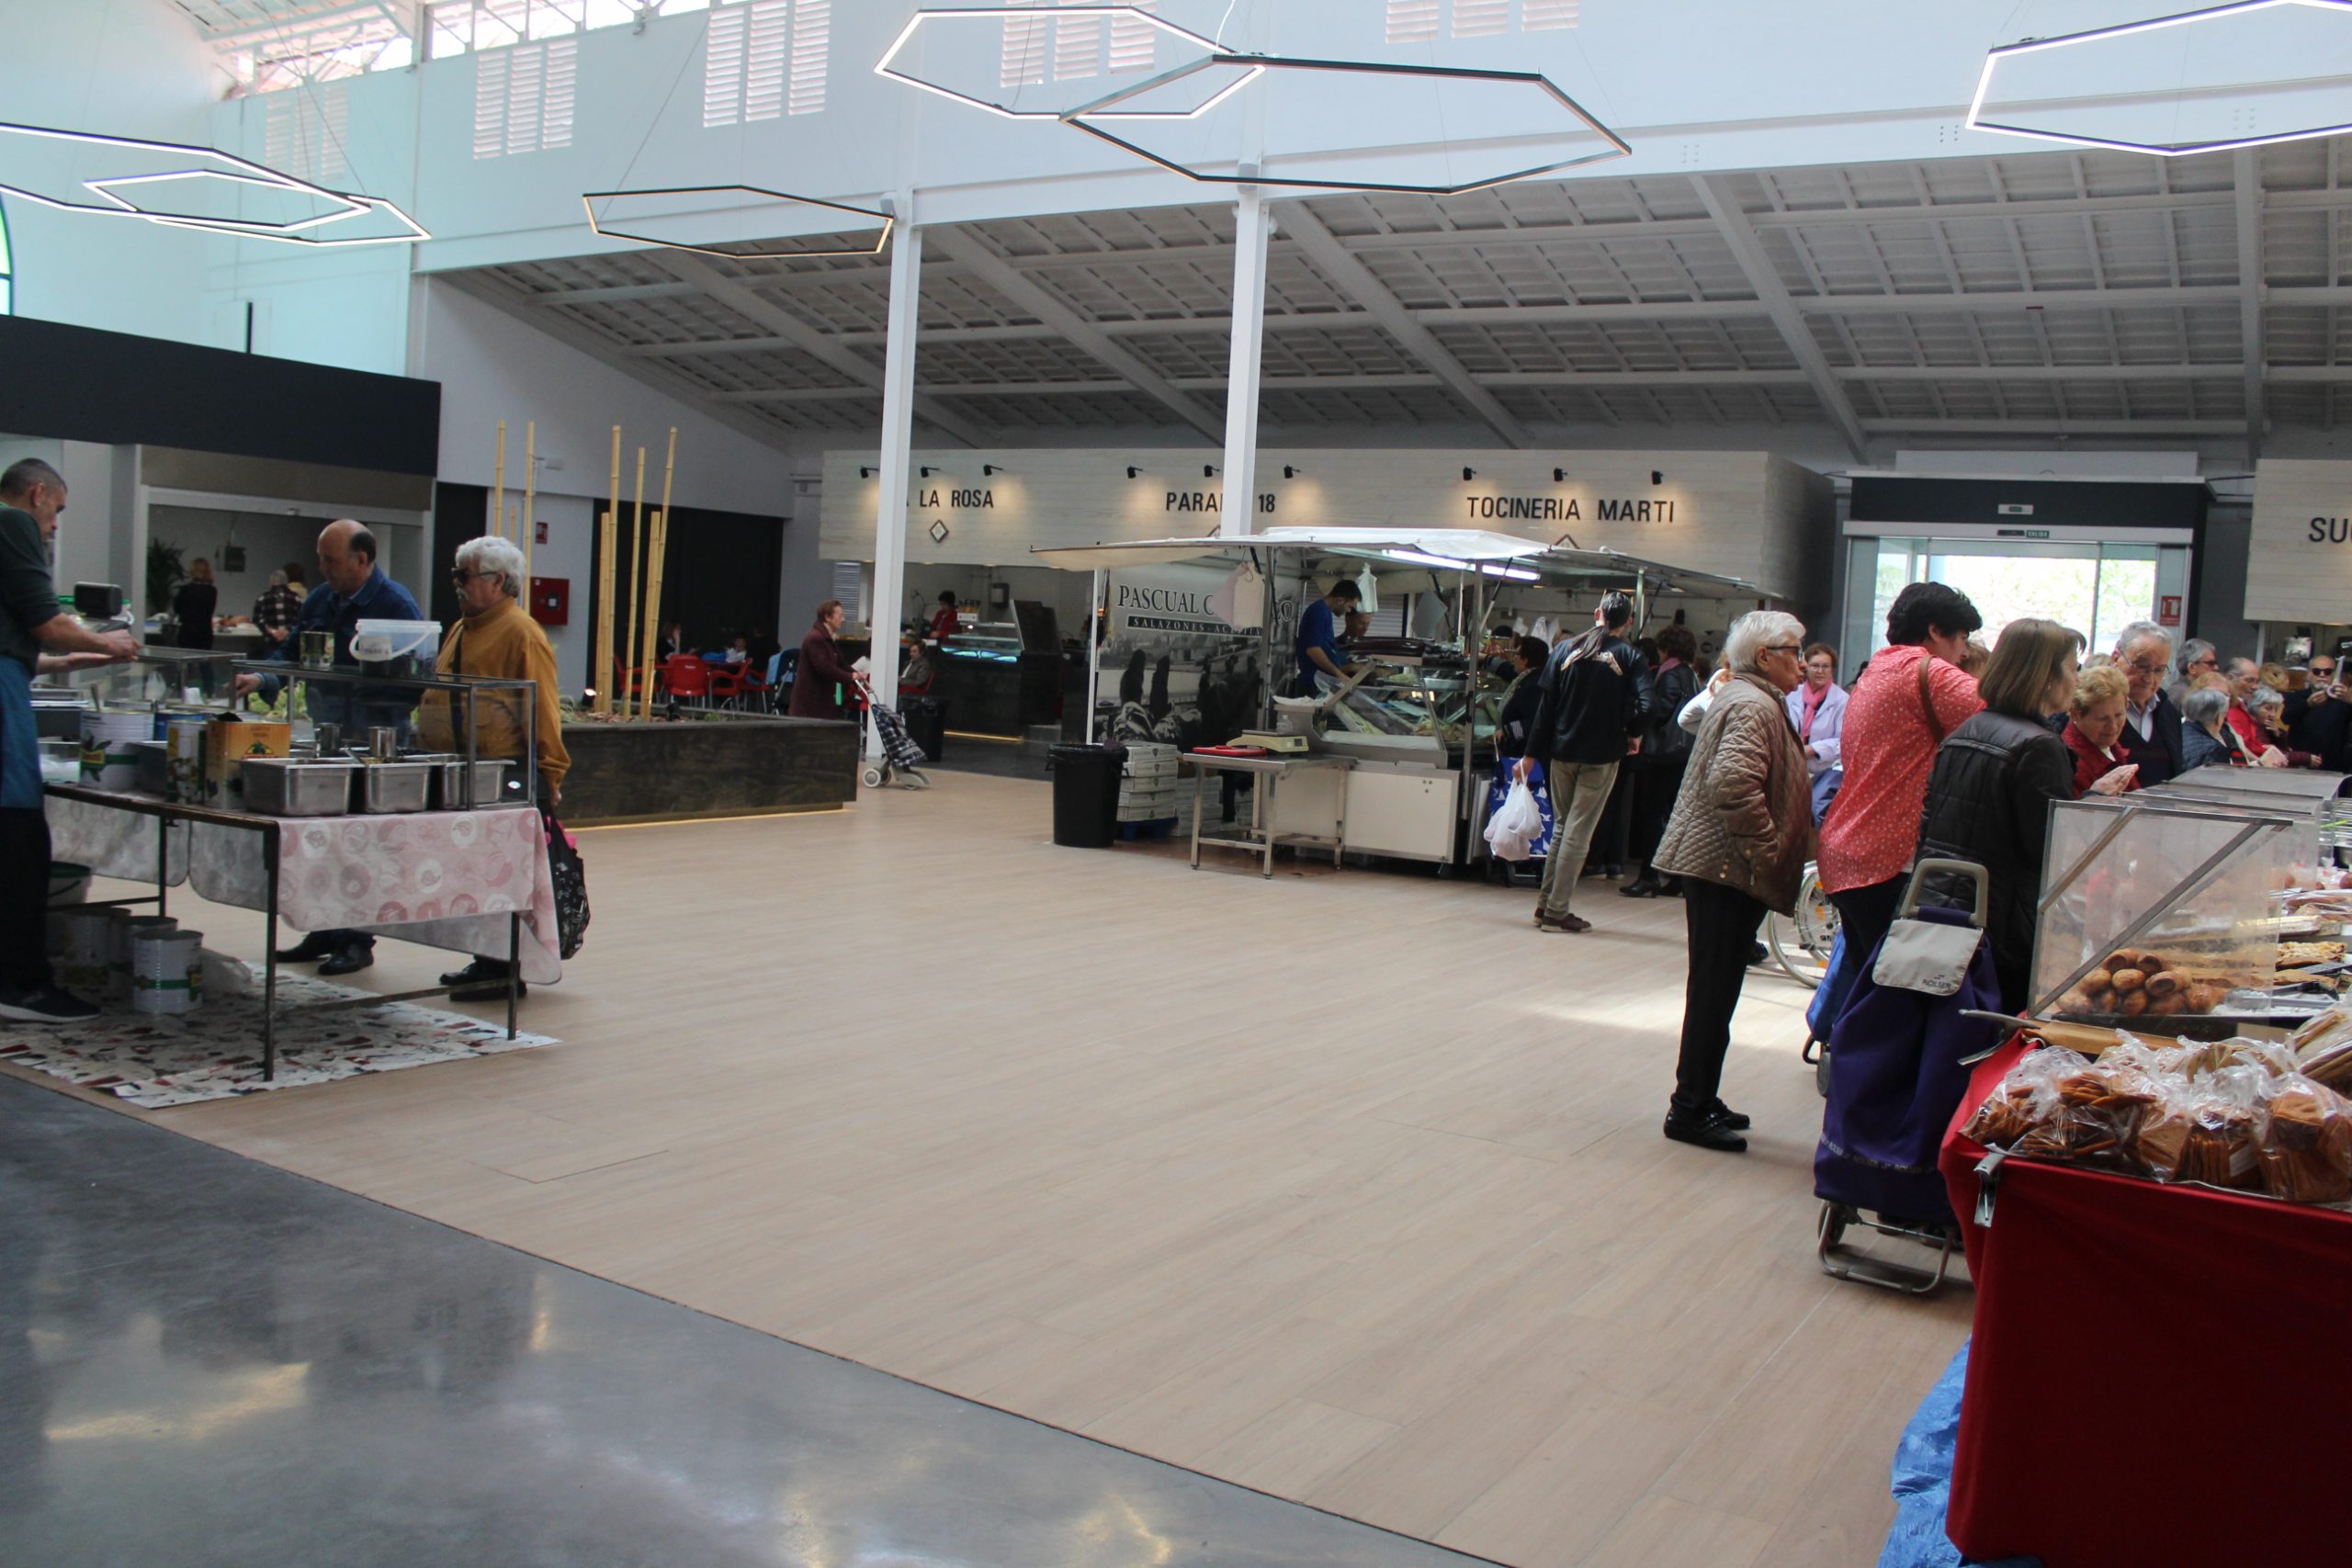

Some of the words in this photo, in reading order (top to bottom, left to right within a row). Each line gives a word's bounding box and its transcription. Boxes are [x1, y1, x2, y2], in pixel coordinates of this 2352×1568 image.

[920, 489, 940, 508] LA
[951, 489, 994, 508] ROSA
[1165, 491, 1223, 513] PARA
[1258, 493, 1276, 513] 18
[1466, 496, 1581, 521] TOCINERIA
[1597, 499, 1675, 523] MARTI
[2308, 516, 2352, 544] SU
[1117, 585, 1200, 615] PASCUAL
[1133, 617, 1205, 633] SALAZONES
